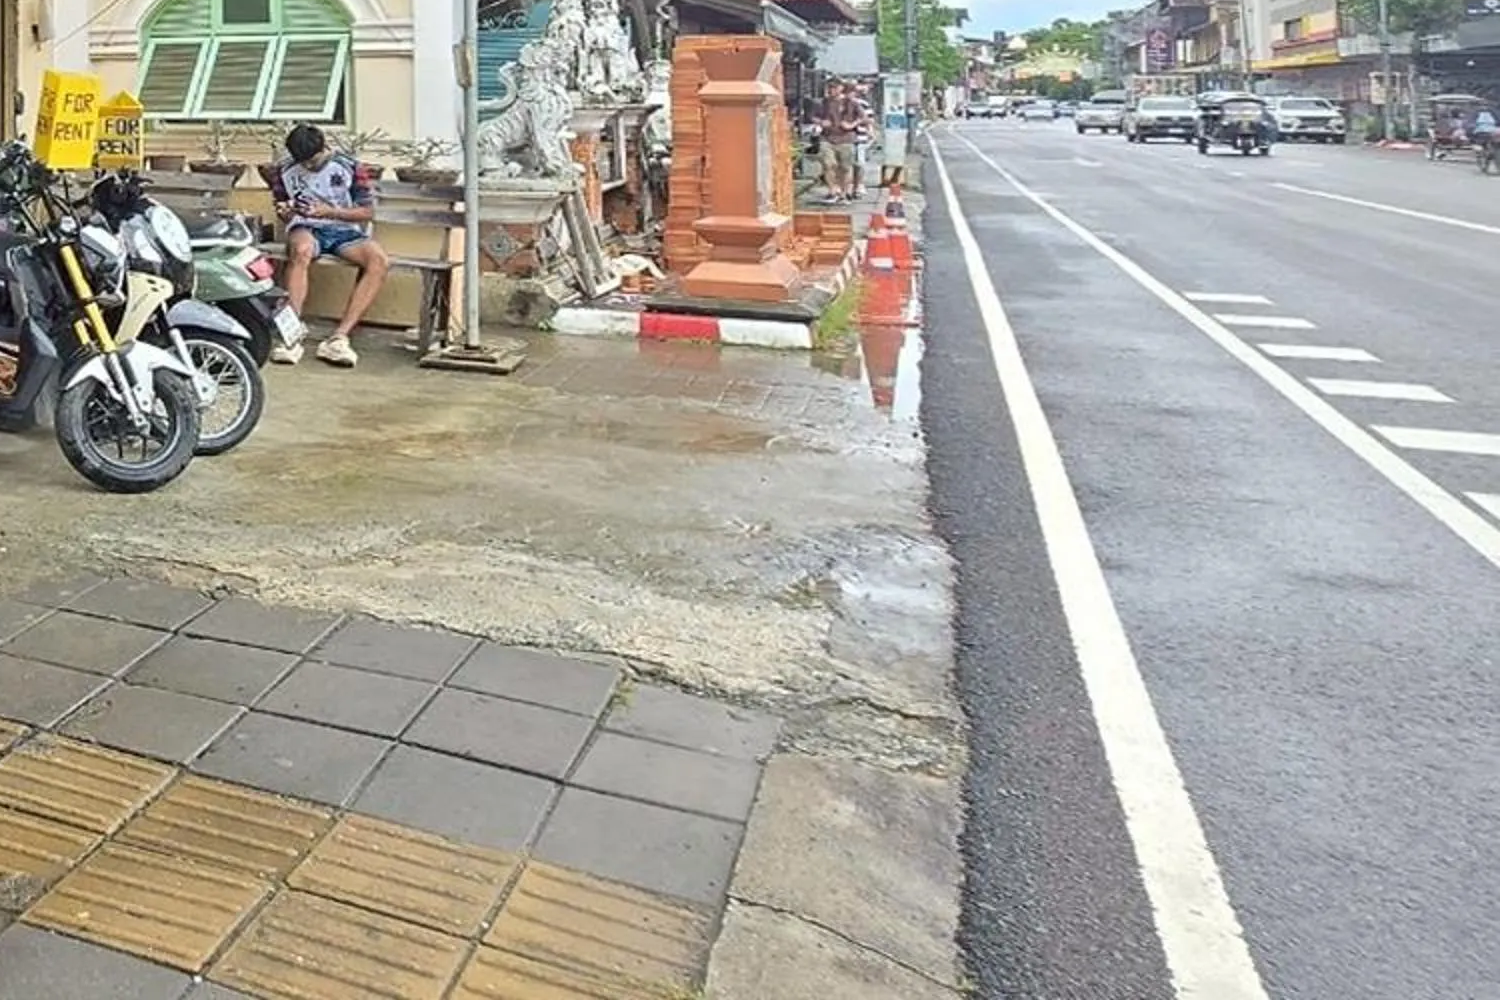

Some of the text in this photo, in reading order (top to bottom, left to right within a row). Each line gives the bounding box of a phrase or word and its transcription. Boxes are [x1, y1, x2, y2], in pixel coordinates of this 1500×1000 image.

[63, 92, 96, 113] FOR
[53, 120, 95, 141] RENT
[104, 117, 139, 137] FOR
[98, 137, 141, 156] RENT
